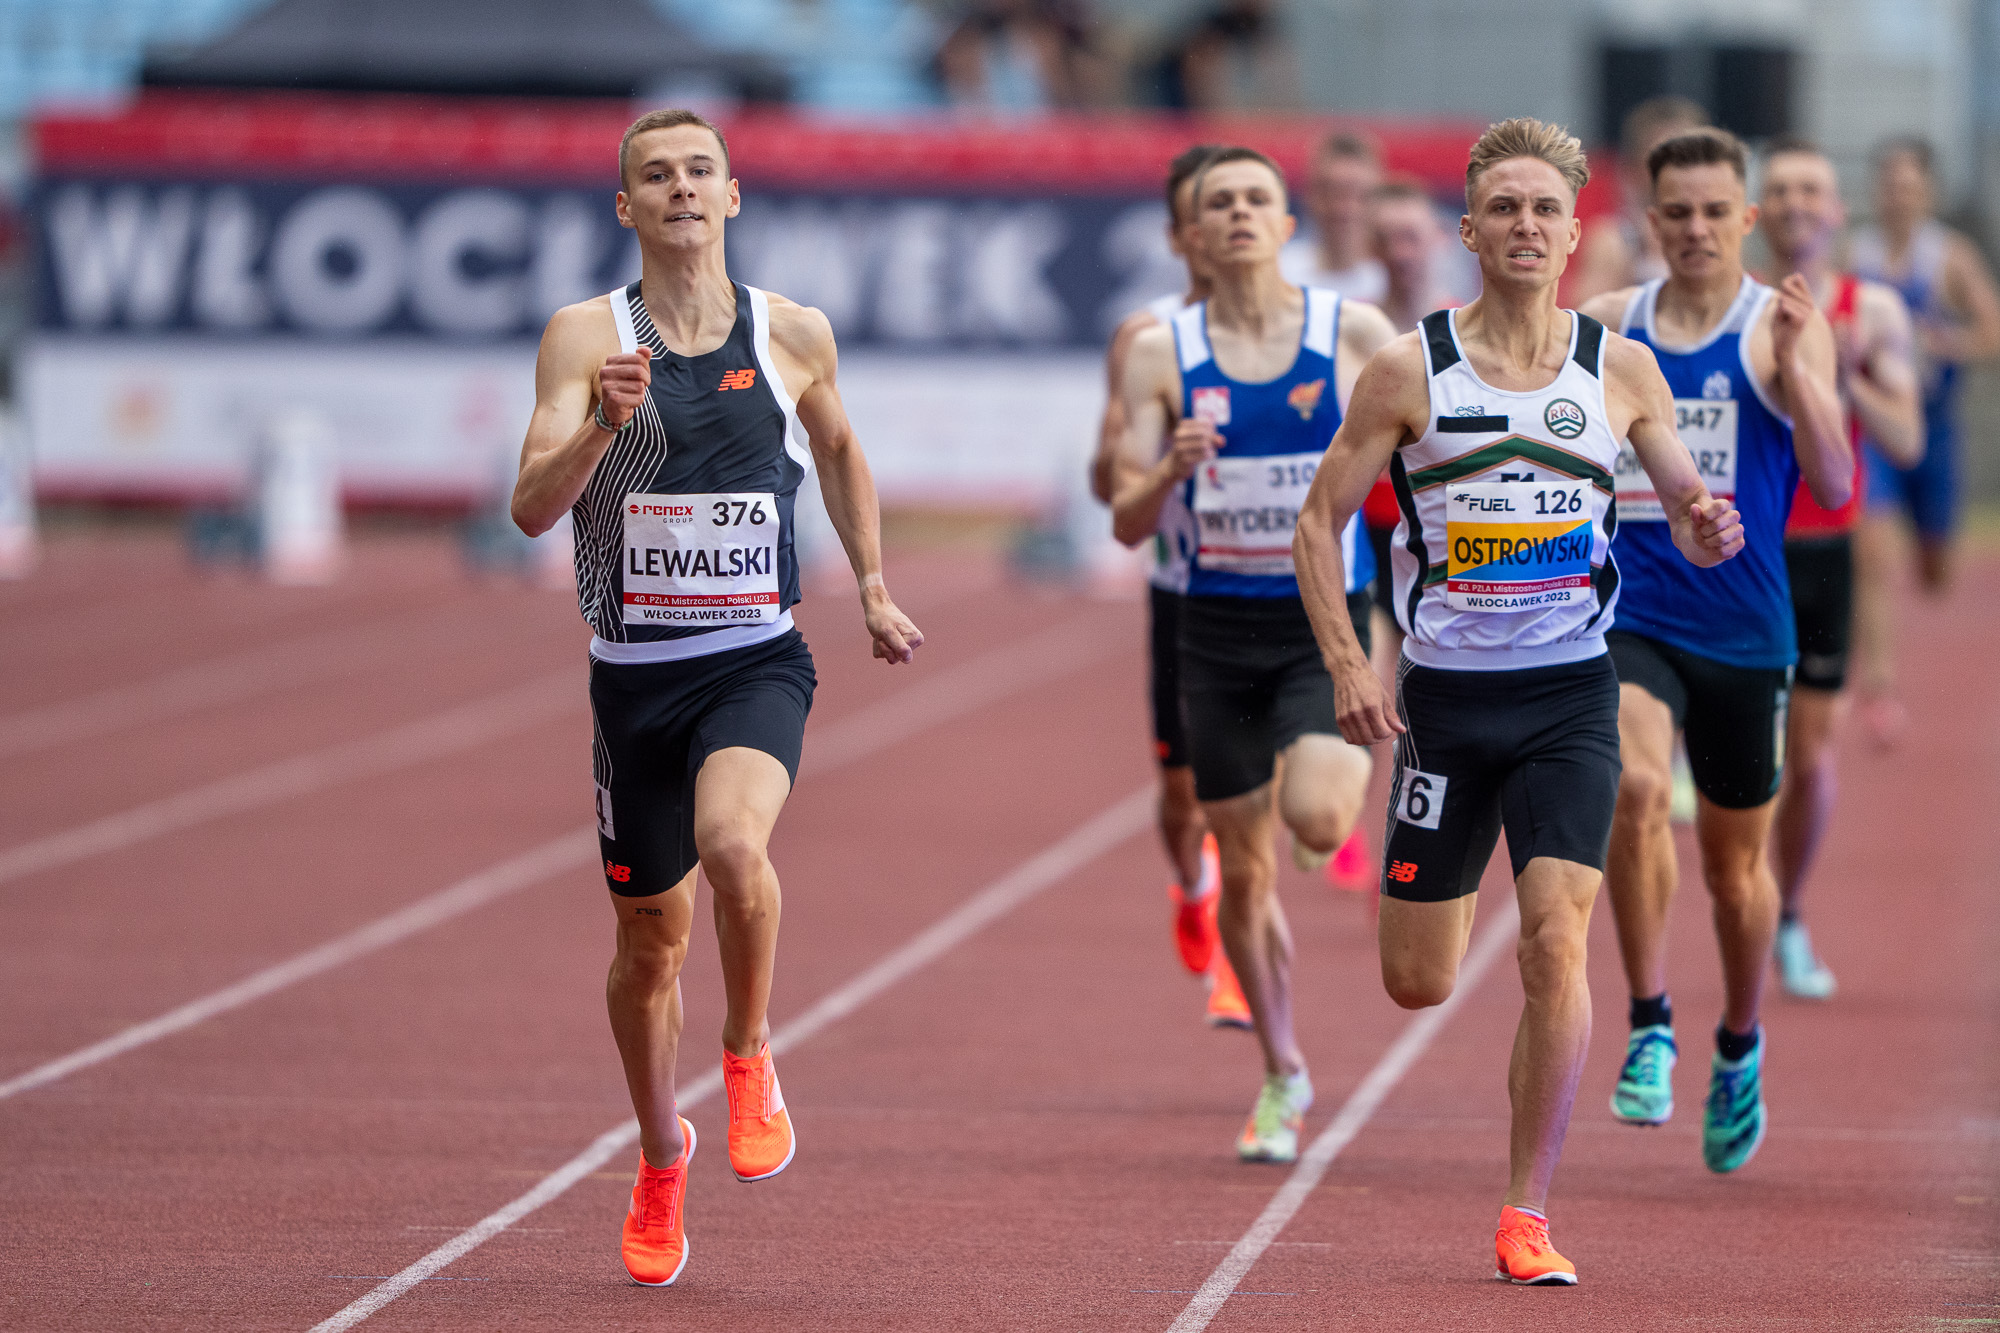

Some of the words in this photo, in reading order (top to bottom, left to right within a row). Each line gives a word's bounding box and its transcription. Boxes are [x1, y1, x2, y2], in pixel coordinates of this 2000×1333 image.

[46, 184, 1072, 334] WŁOCŁWEK
[1455, 405, 1485, 417] esa
[1549, 404, 1579, 421] RKS
[1676, 407, 1722, 430] 347
[1268, 462, 1317, 487] 310
[1469, 498, 1516, 511] FUEL
[1534, 489, 1582, 514] 126
[712, 501, 766, 526] 376
[1454, 534, 1589, 565] OSTROWSKI
[630, 546, 770, 577] LEWALSKI
[1457, 583, 1470, 592] 40.
[1472, 584, 1491, 592] PZLA
[1493, 584, 1542, 593] Mistrzostwa
[1544, 581, 1564, 589] Polski
[1565, 578, 1581, 586] U23
[634, 595, 648, 603] 40.
[649, 596, 669, 604] PZLA
[671, 597, 725, 605] Mistrzostwa
[727, 595, 752, 604] Polski
[753, 594, 770, 603] U23
[1466, 595, 1543, 608] WŁOCŁAWEK
[1544, 591, 1571, 603] 2023
[643, 609, 728, 620] WŁOCŁAWEK
[731, 608, 761, 619] 2023
[596, 787, 606, 831] 4
[1407, 776, 1432, 821] 6
[635, 907, 663, 916] run
